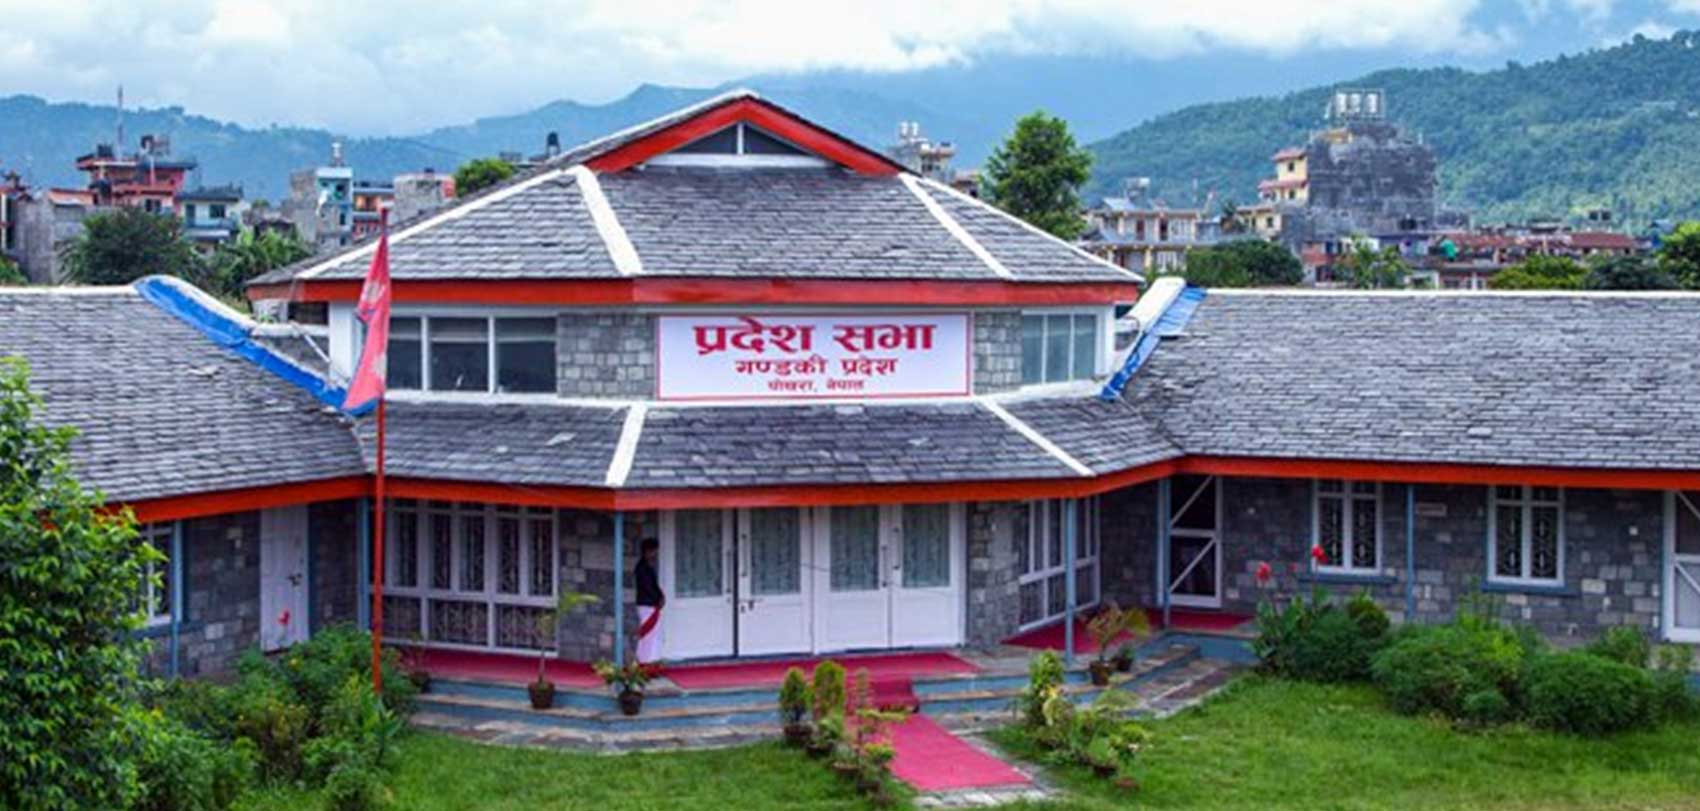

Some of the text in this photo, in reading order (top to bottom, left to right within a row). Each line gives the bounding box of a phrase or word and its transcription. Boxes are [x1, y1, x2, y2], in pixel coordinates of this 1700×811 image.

[693, 316, 936, 354] प्रदेश सभा
[735, 354, 898, 376] गण्डकी प्रदेश
[826, 378, 864, 391] नेपाल
